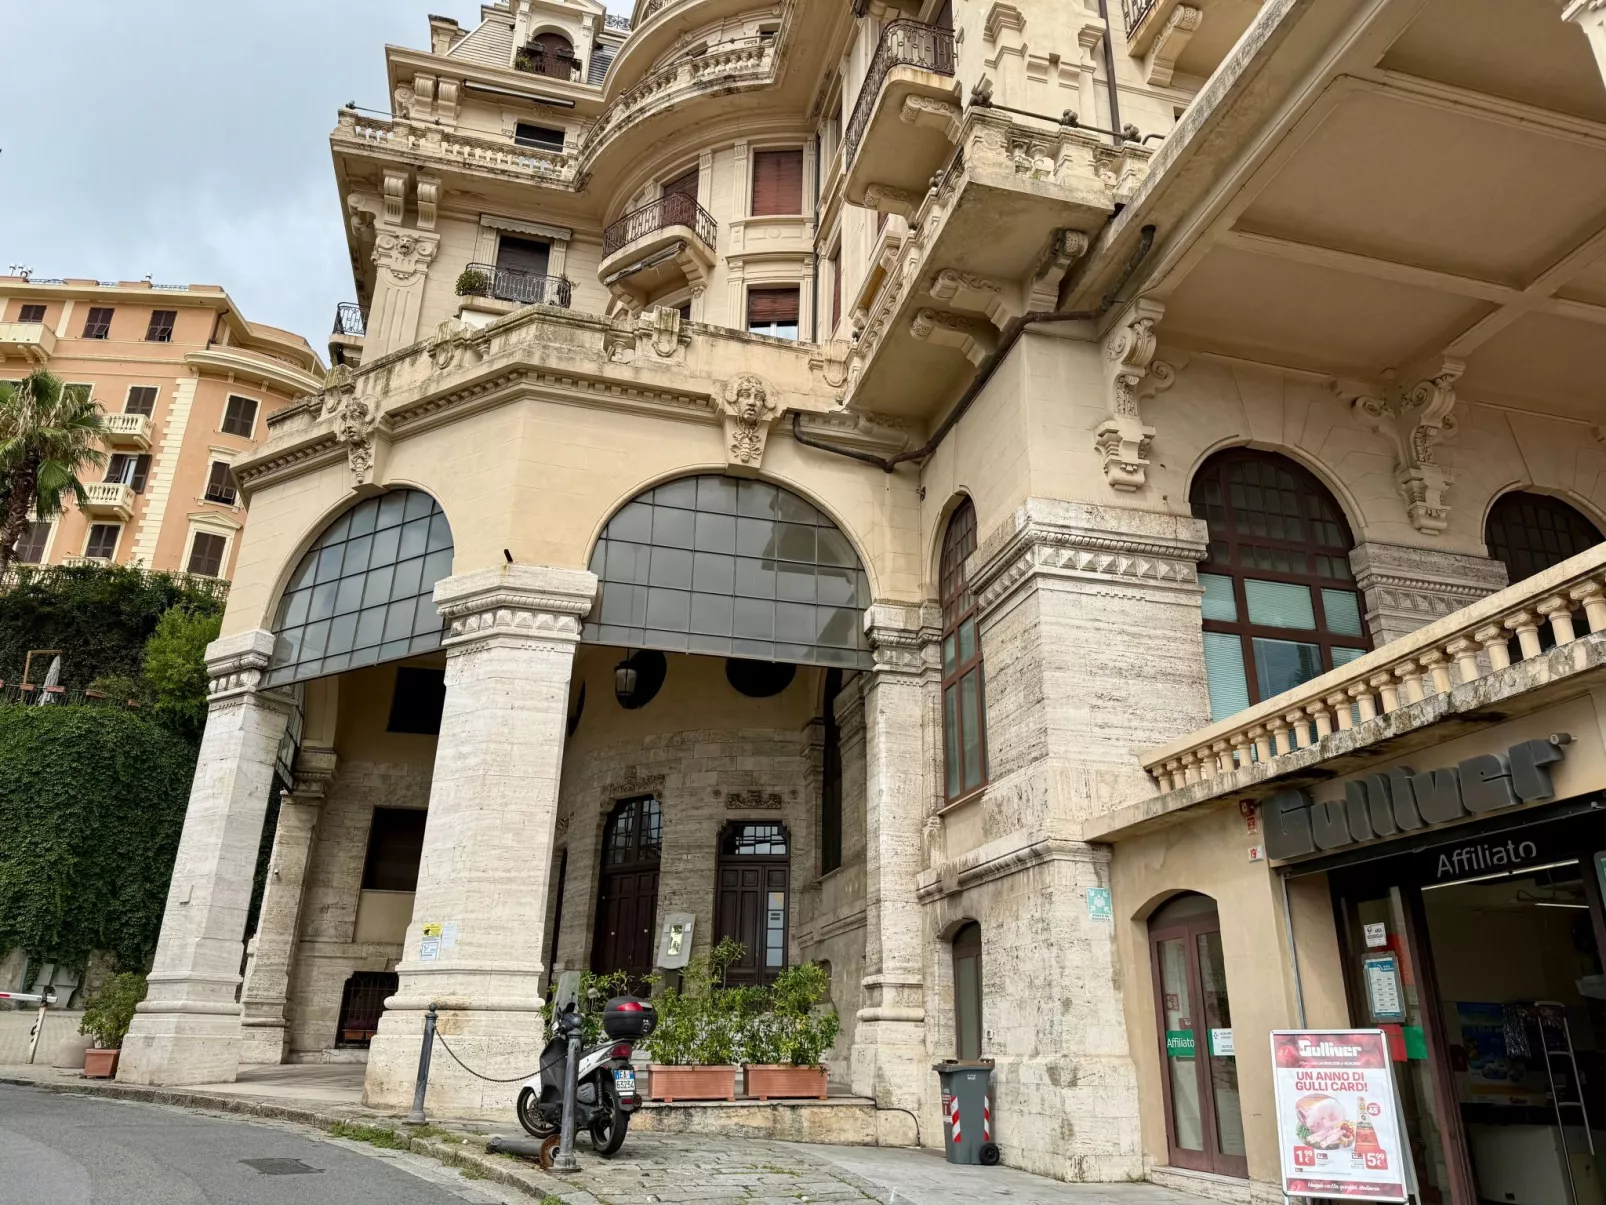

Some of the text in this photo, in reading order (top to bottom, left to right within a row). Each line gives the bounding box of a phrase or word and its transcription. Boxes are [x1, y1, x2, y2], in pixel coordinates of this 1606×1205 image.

[1262, 738, 1564, 860] Gulliver
[1437, 840, 1537, 878] Affiliato
[1167, 1037, 1194, 1048] Affiliato
[1298, 1039, 1362, 1057] Gulliver
[1297, 1072, 1365, 1082] UN ANNO DI
[1295, 1081, 1368, 1092] GULLI CARD!
